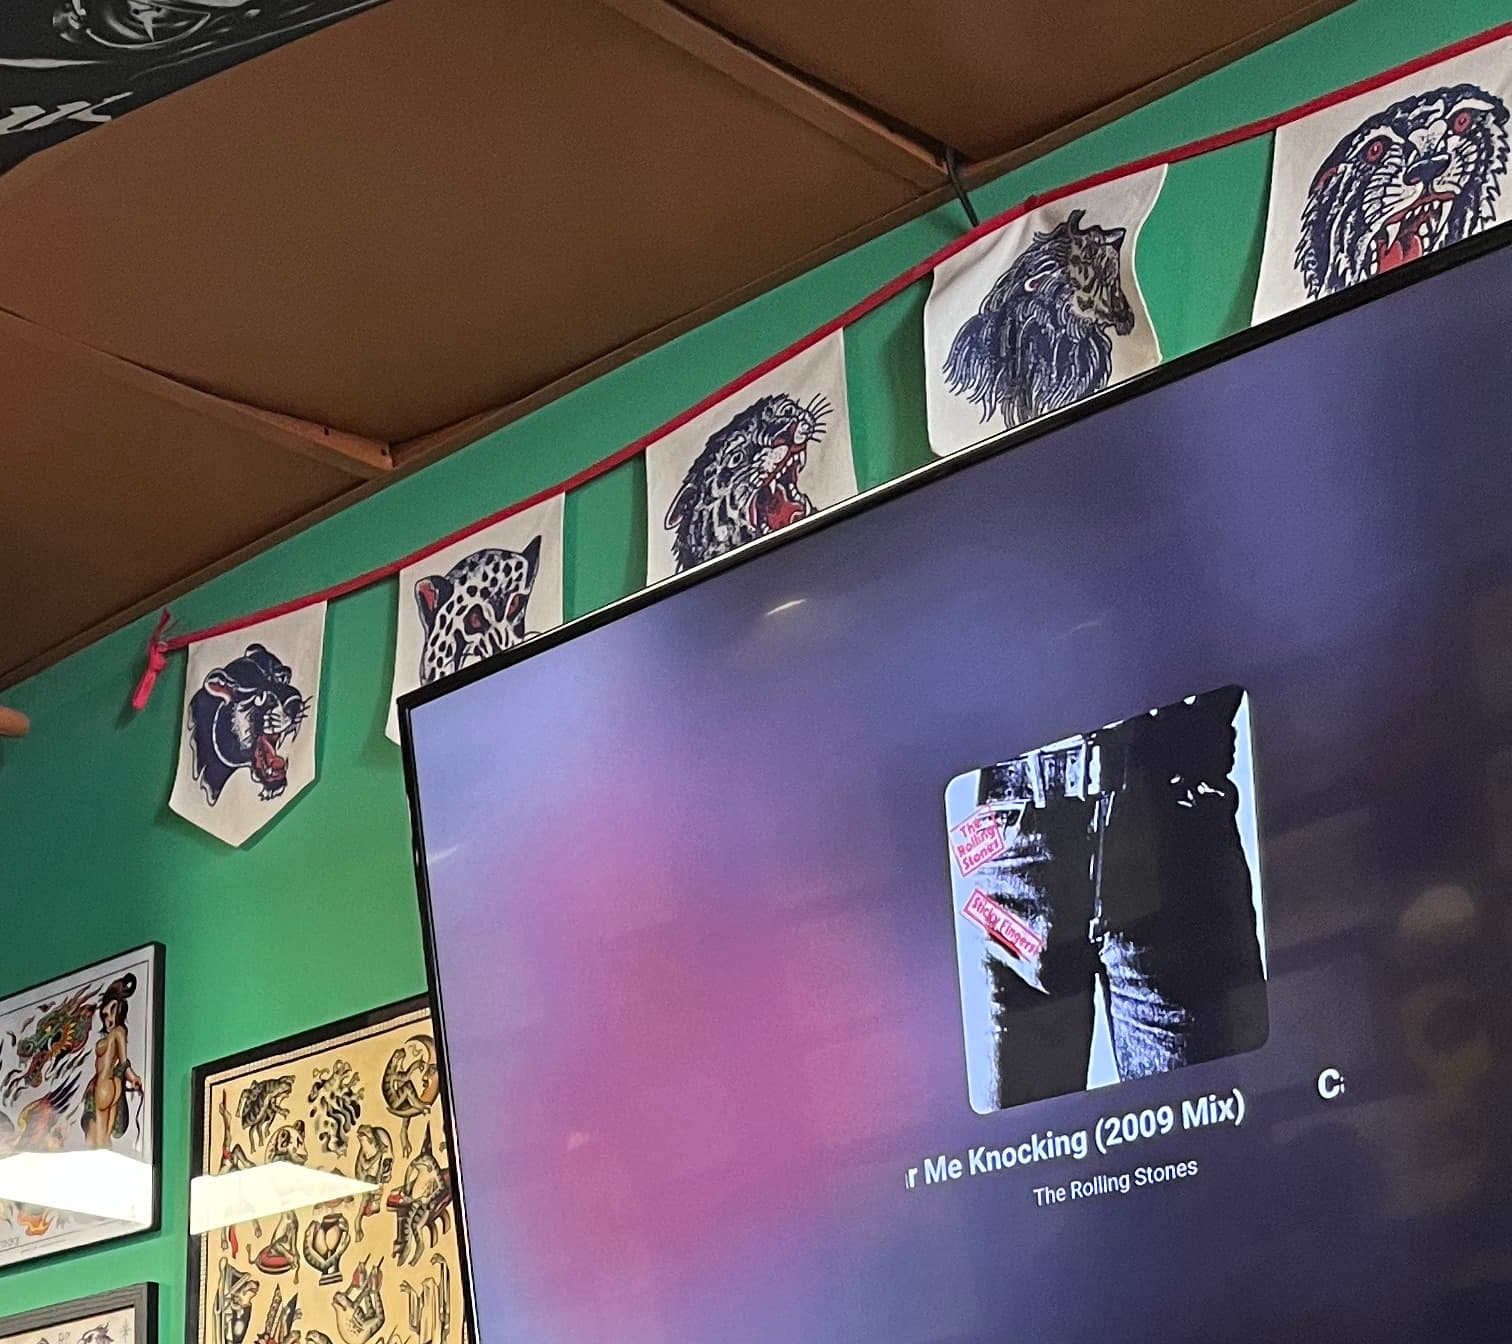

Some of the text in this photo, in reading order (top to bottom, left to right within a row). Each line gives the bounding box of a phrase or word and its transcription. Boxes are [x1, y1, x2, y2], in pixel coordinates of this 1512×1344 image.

[924, 1155, 962, 1186] Me
[968, 1128, 1088, 1173] Knocking
[1095, 1105, 1174, 1155] (2009
[1182, 1087, 1246, 1130] Mix)
[1033, 1160, 1199, 1207] The Rolling Stones
